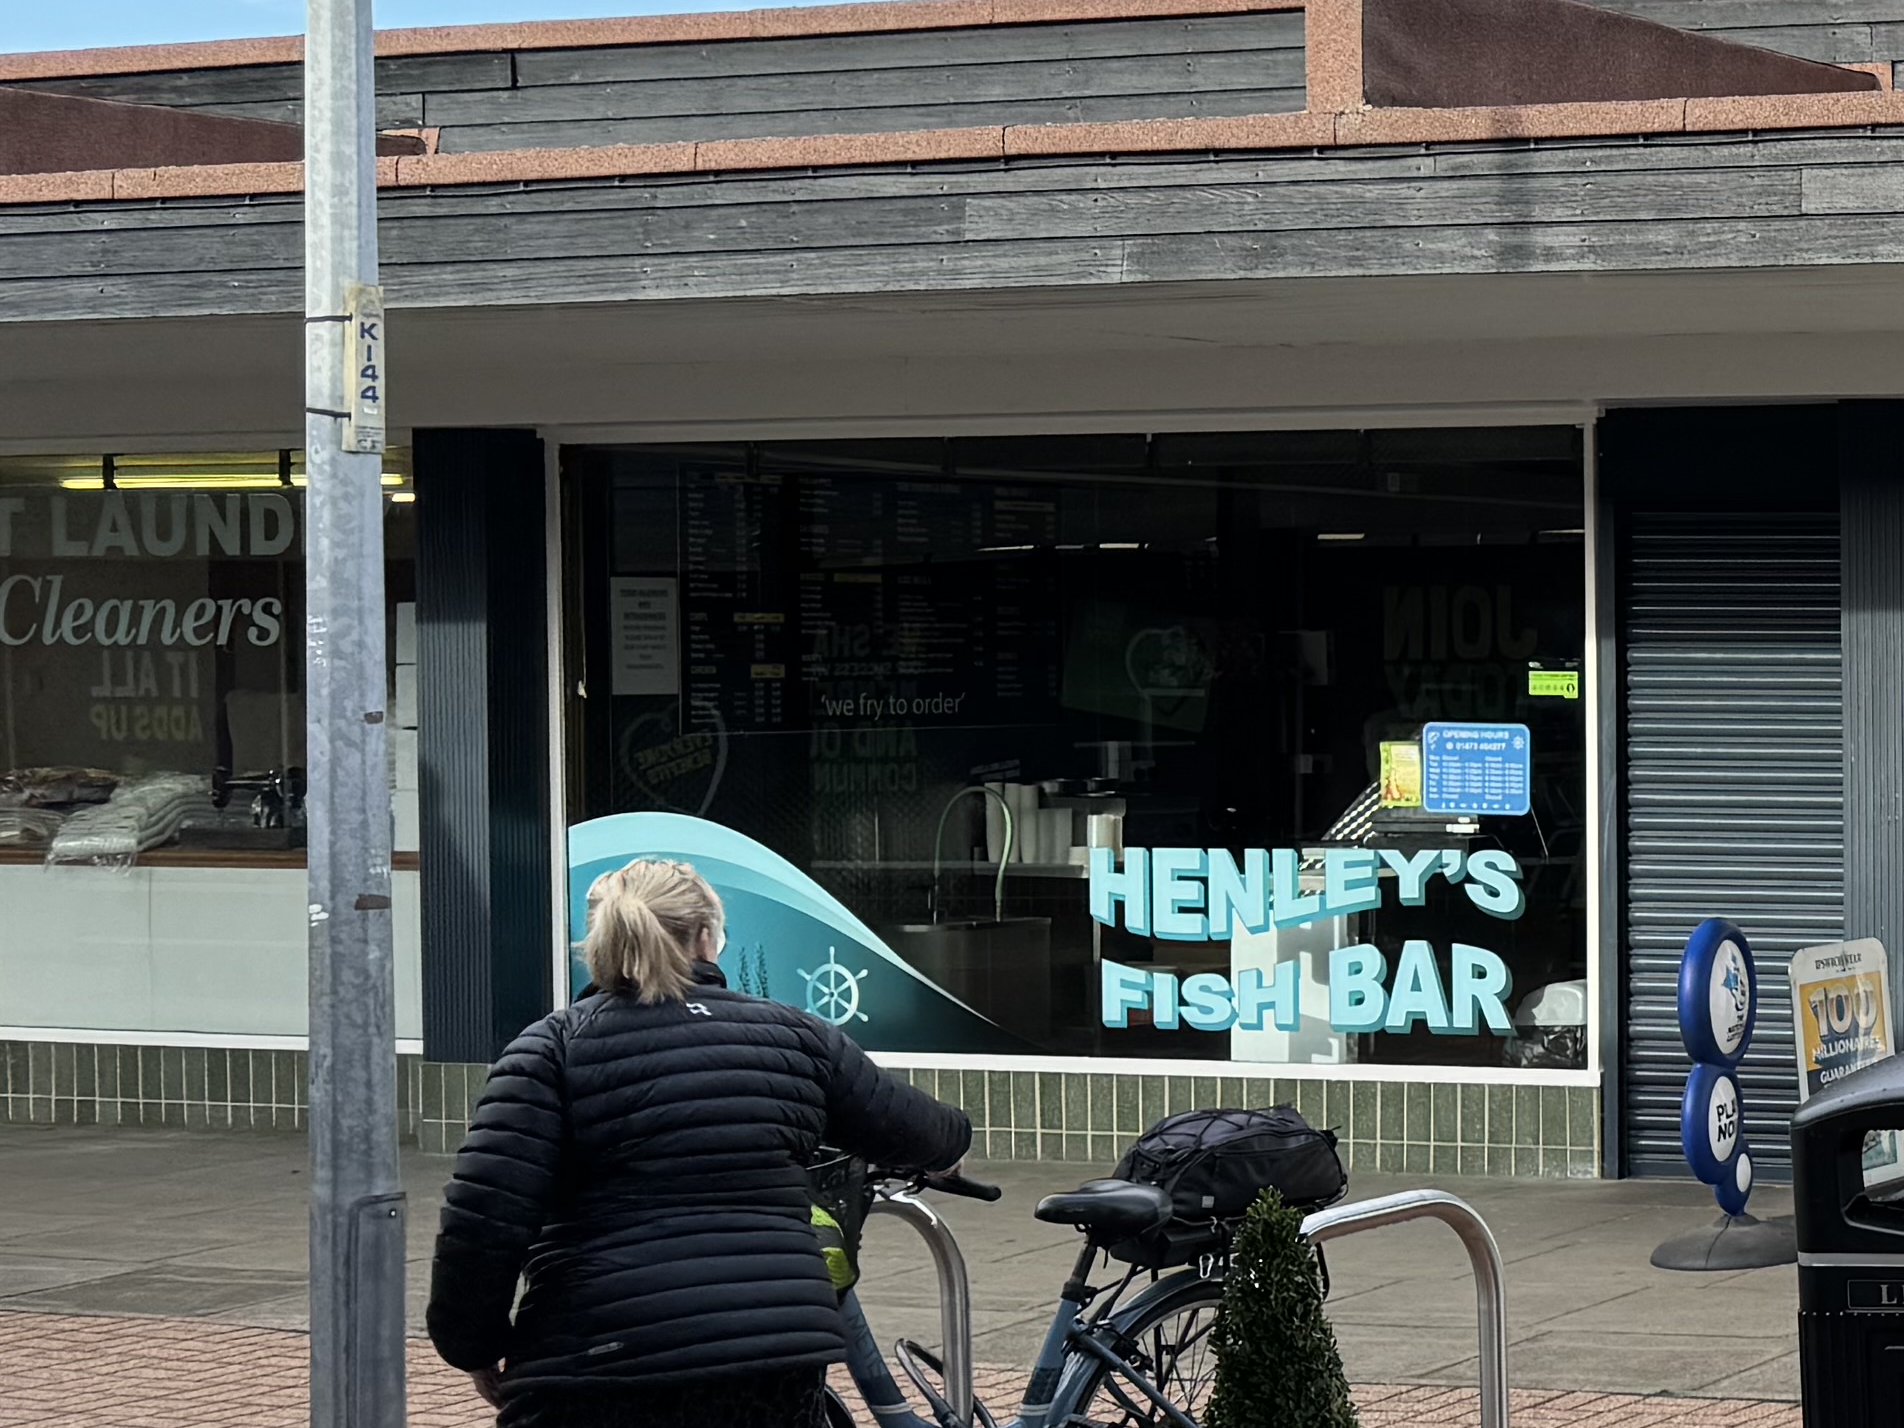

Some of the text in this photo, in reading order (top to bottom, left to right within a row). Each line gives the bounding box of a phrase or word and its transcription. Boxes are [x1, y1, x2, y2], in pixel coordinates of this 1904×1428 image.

[360, 321, 379, 404] K144
[0, 574, 283, 647] Cleaners
[858, 692, 885, 722] fry
[889, 694, 908, 716] to
[1442, 730, 1510, 740] OPENING HOURS
[1101, 939, 1516, 1037] FISH BAR
[1808, 982, 1878, 1039] 100
